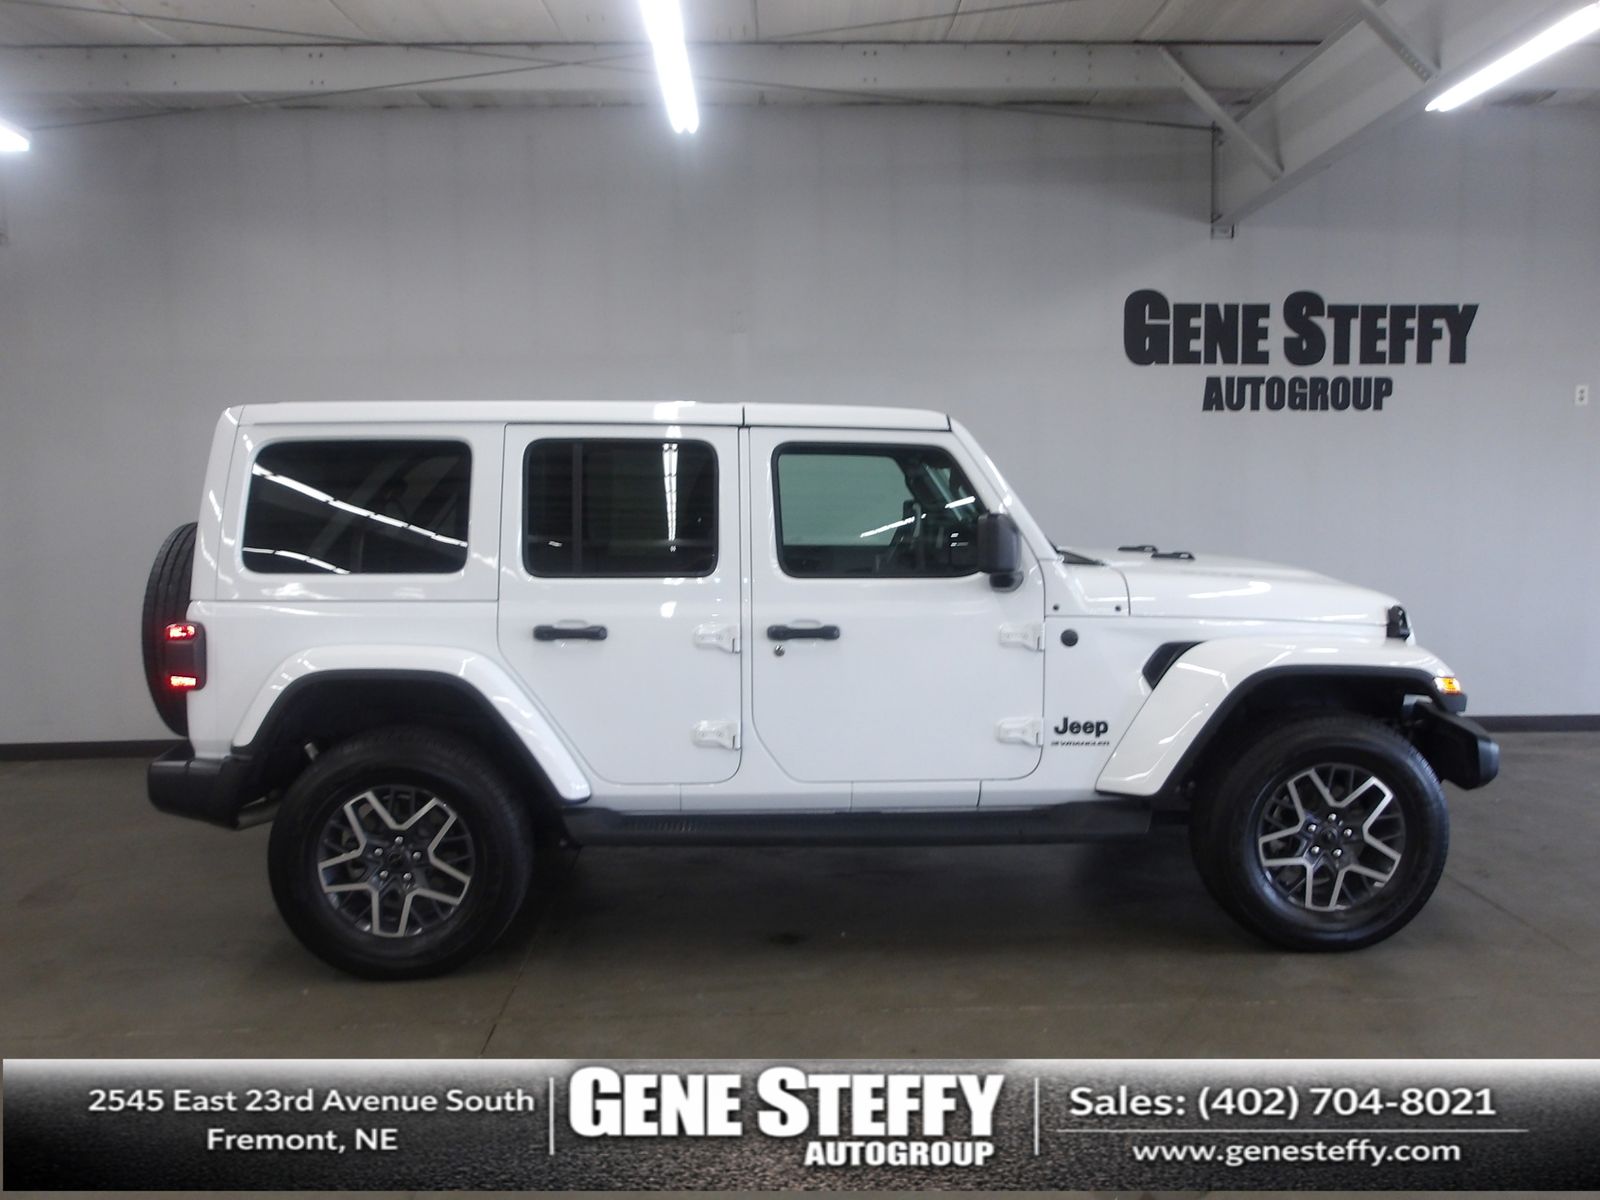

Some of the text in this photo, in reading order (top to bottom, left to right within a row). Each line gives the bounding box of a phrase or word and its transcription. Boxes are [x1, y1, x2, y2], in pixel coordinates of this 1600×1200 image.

[1123, 289, 1479, 366] GENE STEFFY
[1203, 377, 1393, 412] AUTOGROUP
[1053, 716, 1109, 738] Jeep
